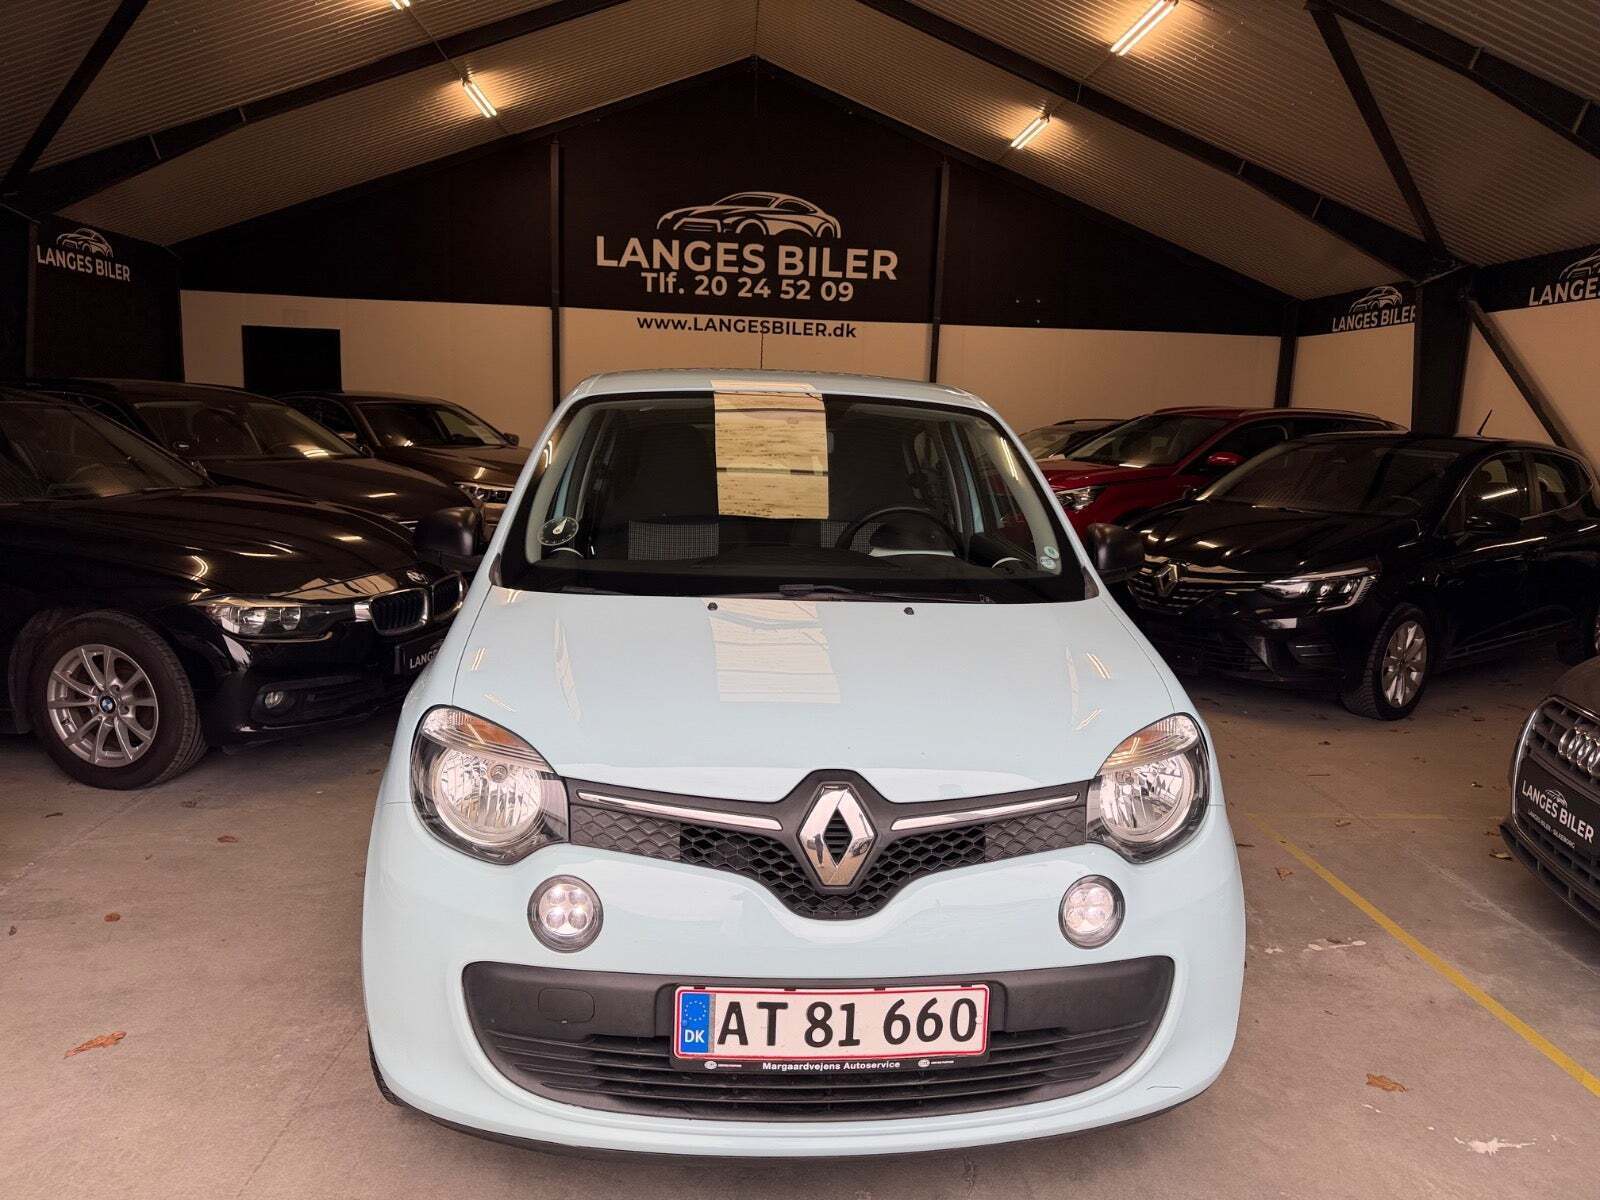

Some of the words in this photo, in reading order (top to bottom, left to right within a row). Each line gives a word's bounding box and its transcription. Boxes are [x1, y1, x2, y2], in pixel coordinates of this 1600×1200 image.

[36, 244, 93, 274] LANGES
[95, 258, 131, 282] BILER
[596, 235, 767, 275] LANGES
[777, 245, 898, 281] BILER
[640, 271, 685, 295] Tlf.
[694, 274, 728, 296] 20
[737, 277, 772, 299] 24
[779, 279, 811, 301] 52
[820, 281, 854, 302] 09
[1528, 277, 1600, 307] LANGE
[636, 316, 857, 338] www.LANGESBILER.dk
[1332, 311, 1379, 332] LANGES
[1522, 779, 1558, 818] LANGES
[1559, 807, 1594, 844] BILER
[684, 1029, 705, 1044] DK
[716, 1001, 789, 1047] AT
[803, 1001, 861, 1048] 81
[883, 997, 978, 1045] 660
[762, 1061, 841, 1072] Margaardvejens
[843, 1060, 901, 1070] Autoservice
